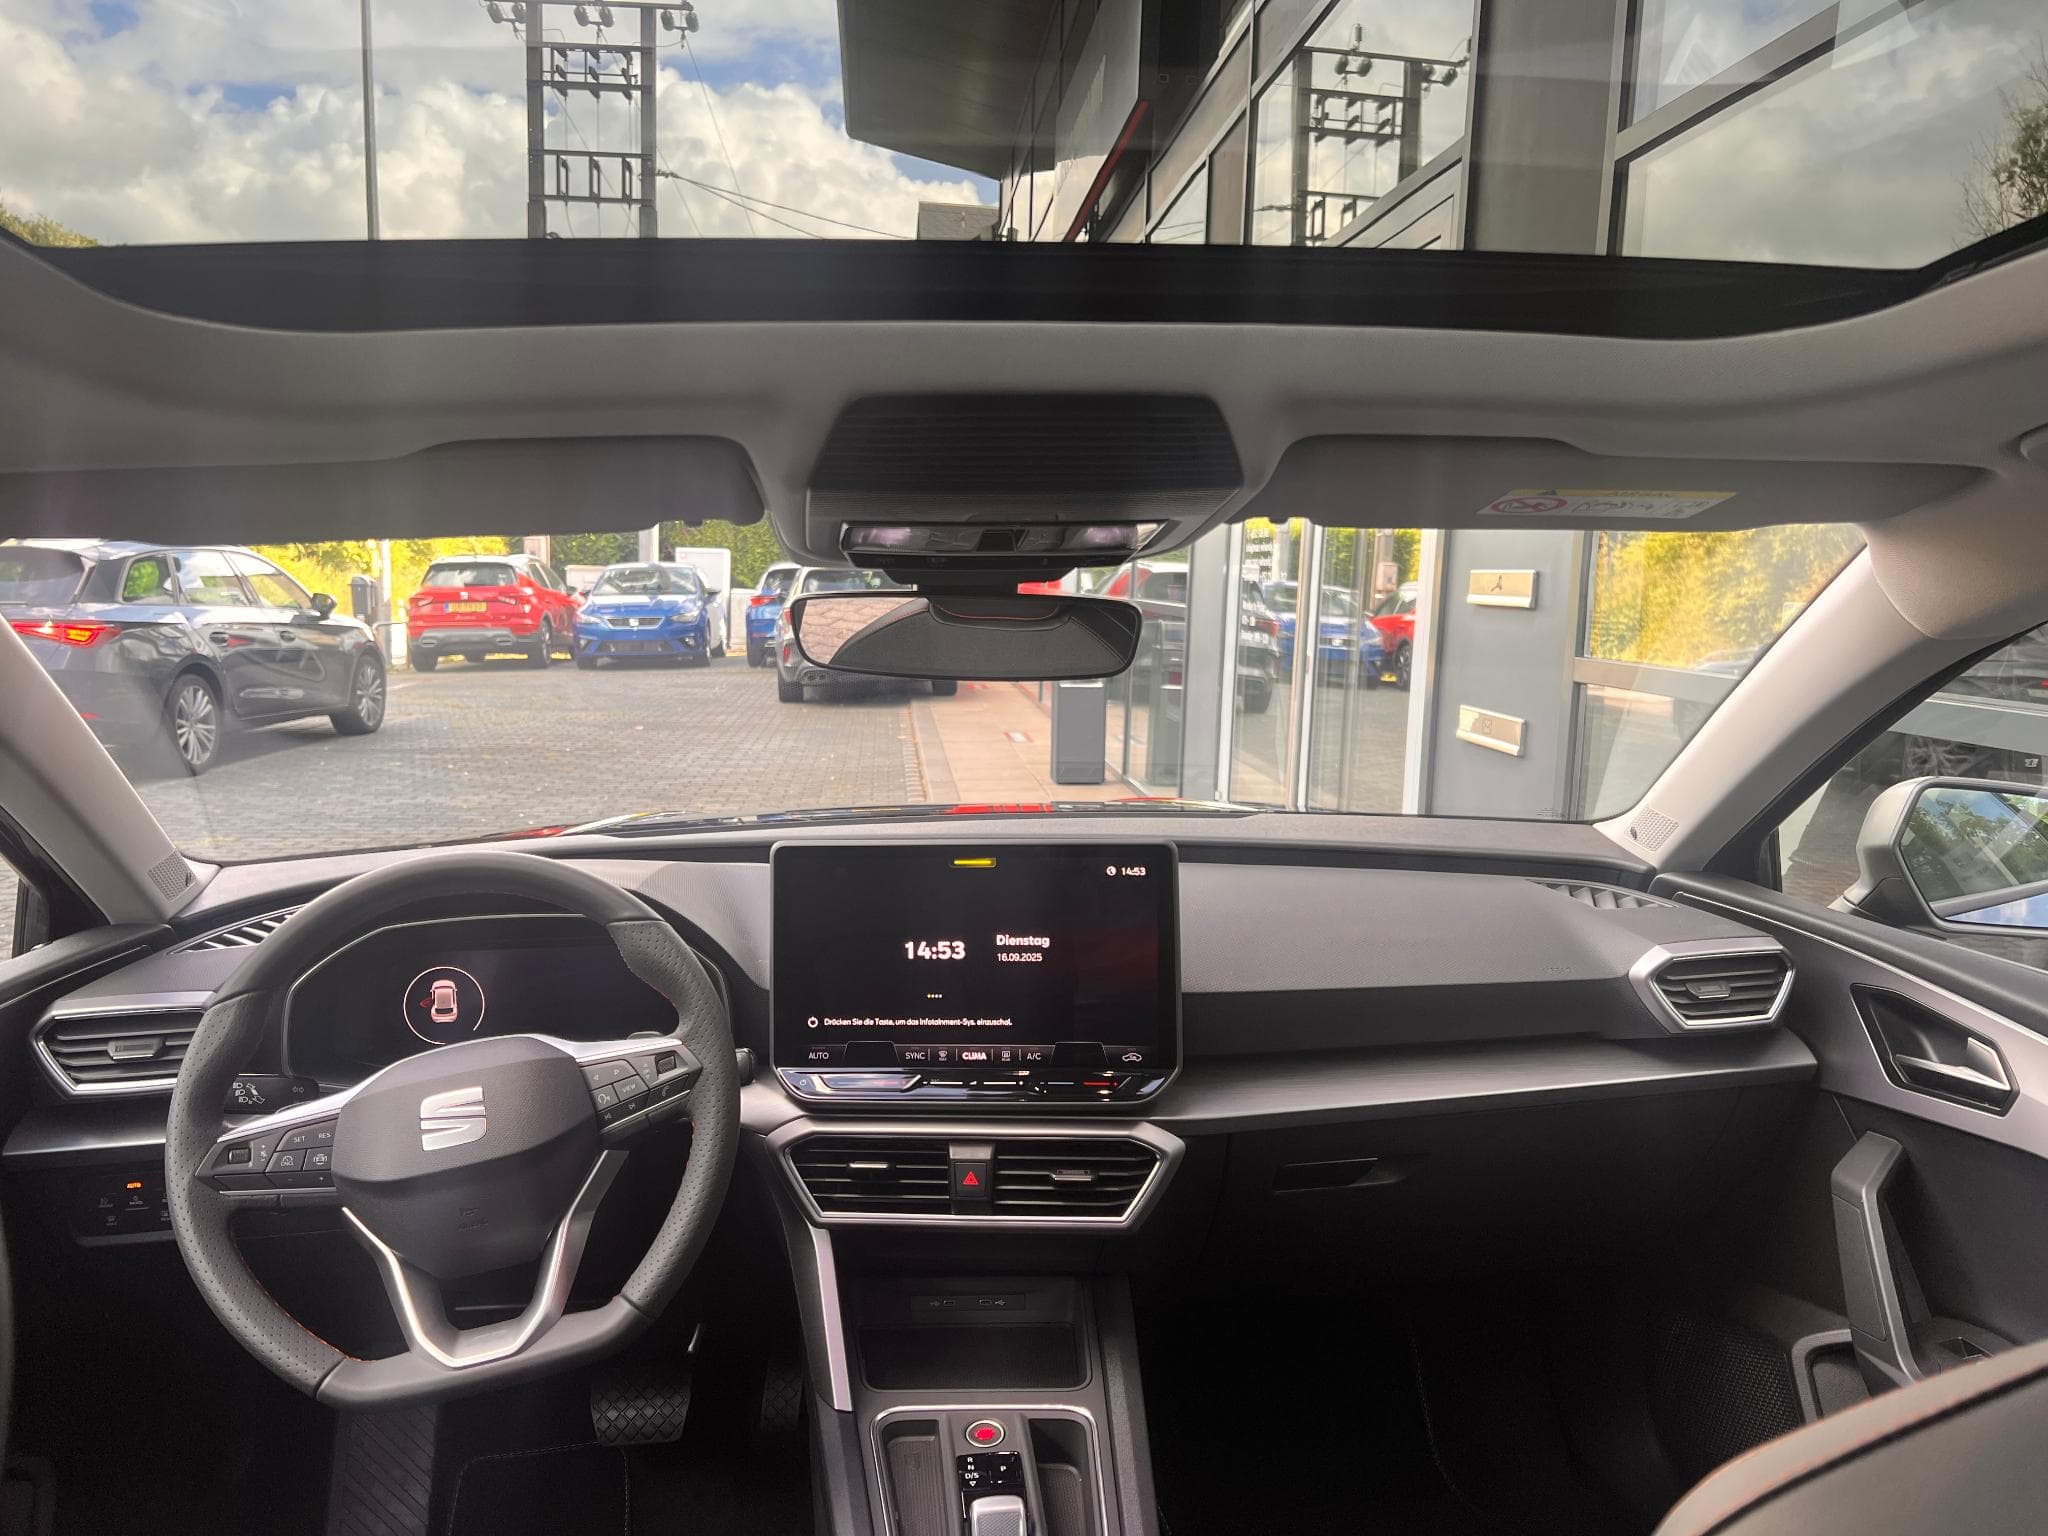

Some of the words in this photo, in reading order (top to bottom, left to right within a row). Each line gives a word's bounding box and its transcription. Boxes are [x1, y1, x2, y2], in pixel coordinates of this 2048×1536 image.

[1121, 866, 1146, 876] 14:53
[996, 935, 1050, 948] Dienstag
[904, 941, 966, 960] 14:53
[997, 953, 1042, 962] 16.09.2025
[852, 1017, 863, 1026] Sie
[863, 1017, 874, 1026] die
[906, 1017, 919, 1026] das
[808, 1052, 829, 1060] AUTO
[905, 1052, 926, 1060] SYNC
[962, 1051, 987, 1060] CLIMA
[1026, 1052, 1042, 1061] A/C
